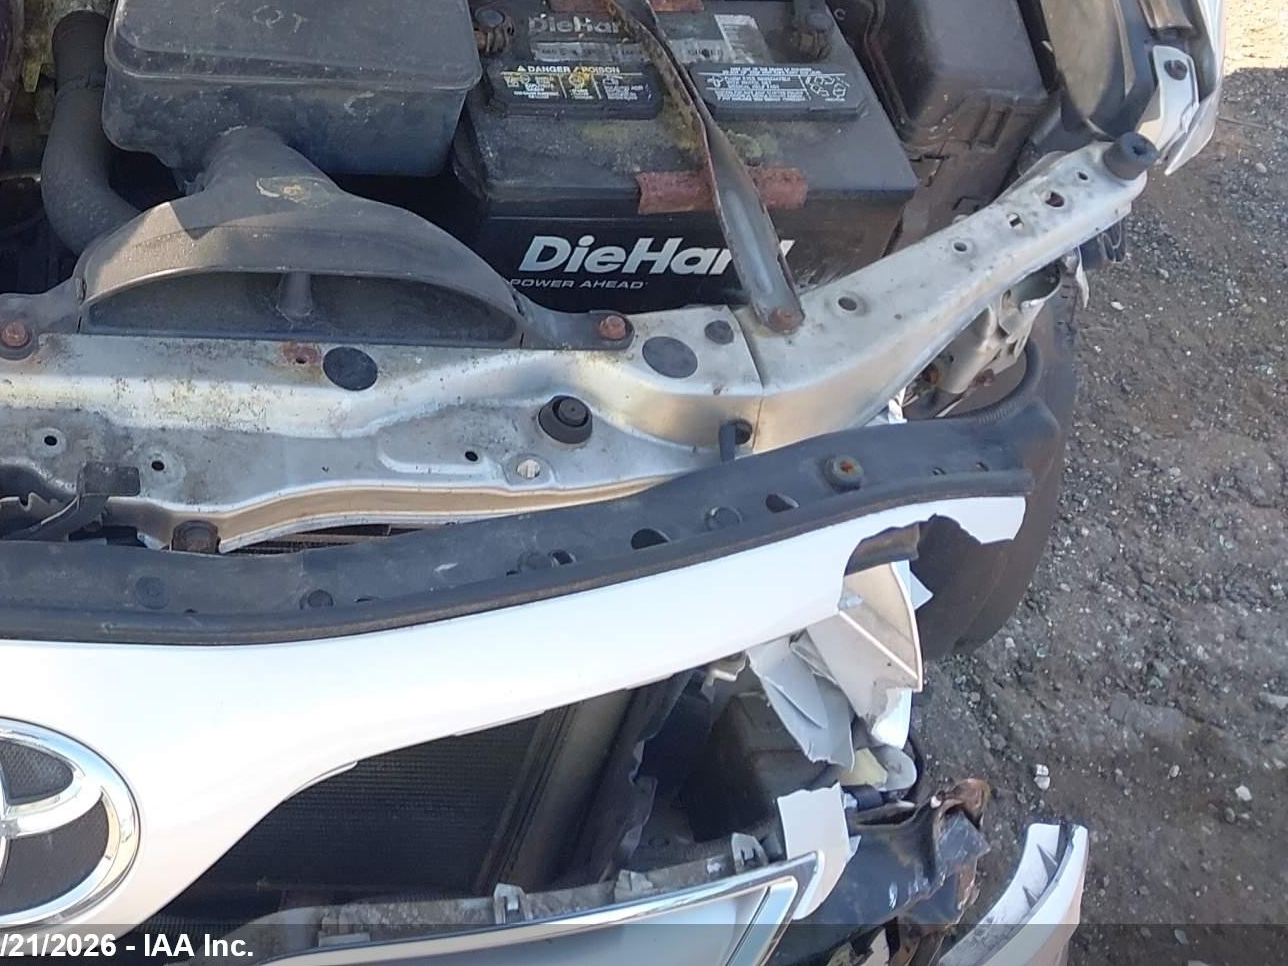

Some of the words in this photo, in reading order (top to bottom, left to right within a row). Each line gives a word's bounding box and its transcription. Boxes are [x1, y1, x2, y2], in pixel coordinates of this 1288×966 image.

[528, 14, 620, 34] DieHar
[518, 234, 796, 275] DieHar
[509, 278, 574, 289] POWER
[579, 279, 644, 290] AHEAD
